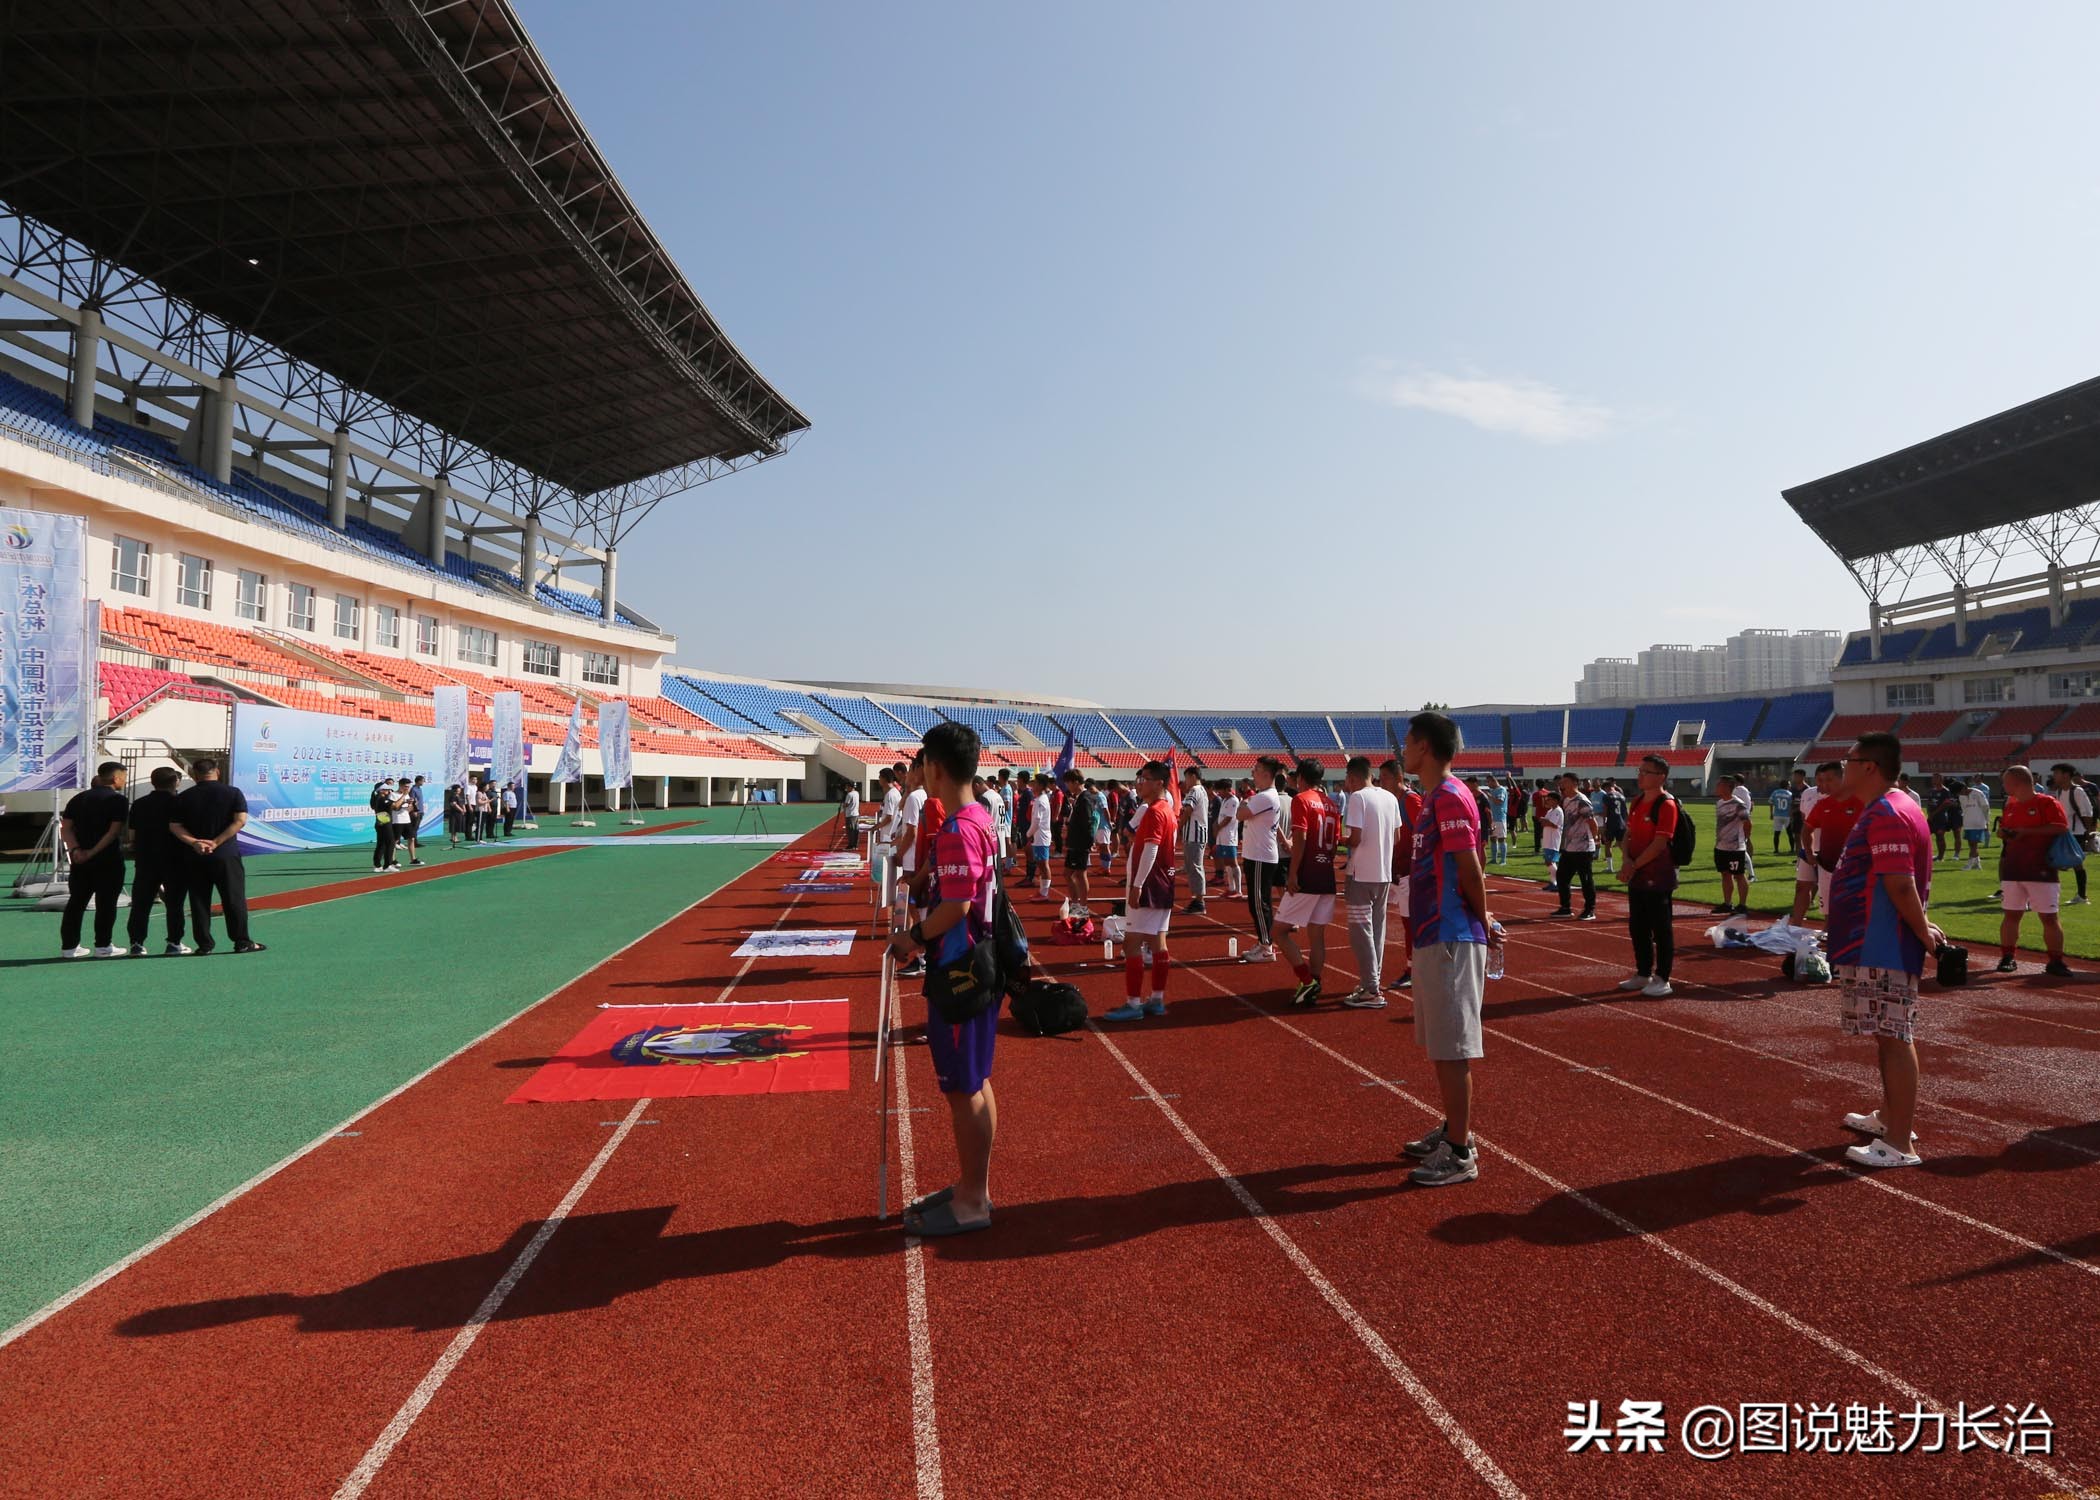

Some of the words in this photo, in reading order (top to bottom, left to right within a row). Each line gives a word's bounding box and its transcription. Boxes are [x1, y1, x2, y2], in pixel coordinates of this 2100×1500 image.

[1776, 797, 1788, 810] 10
[1317, 813, 1336, 850] 10
[1729, 861, 1739, 871] 37
